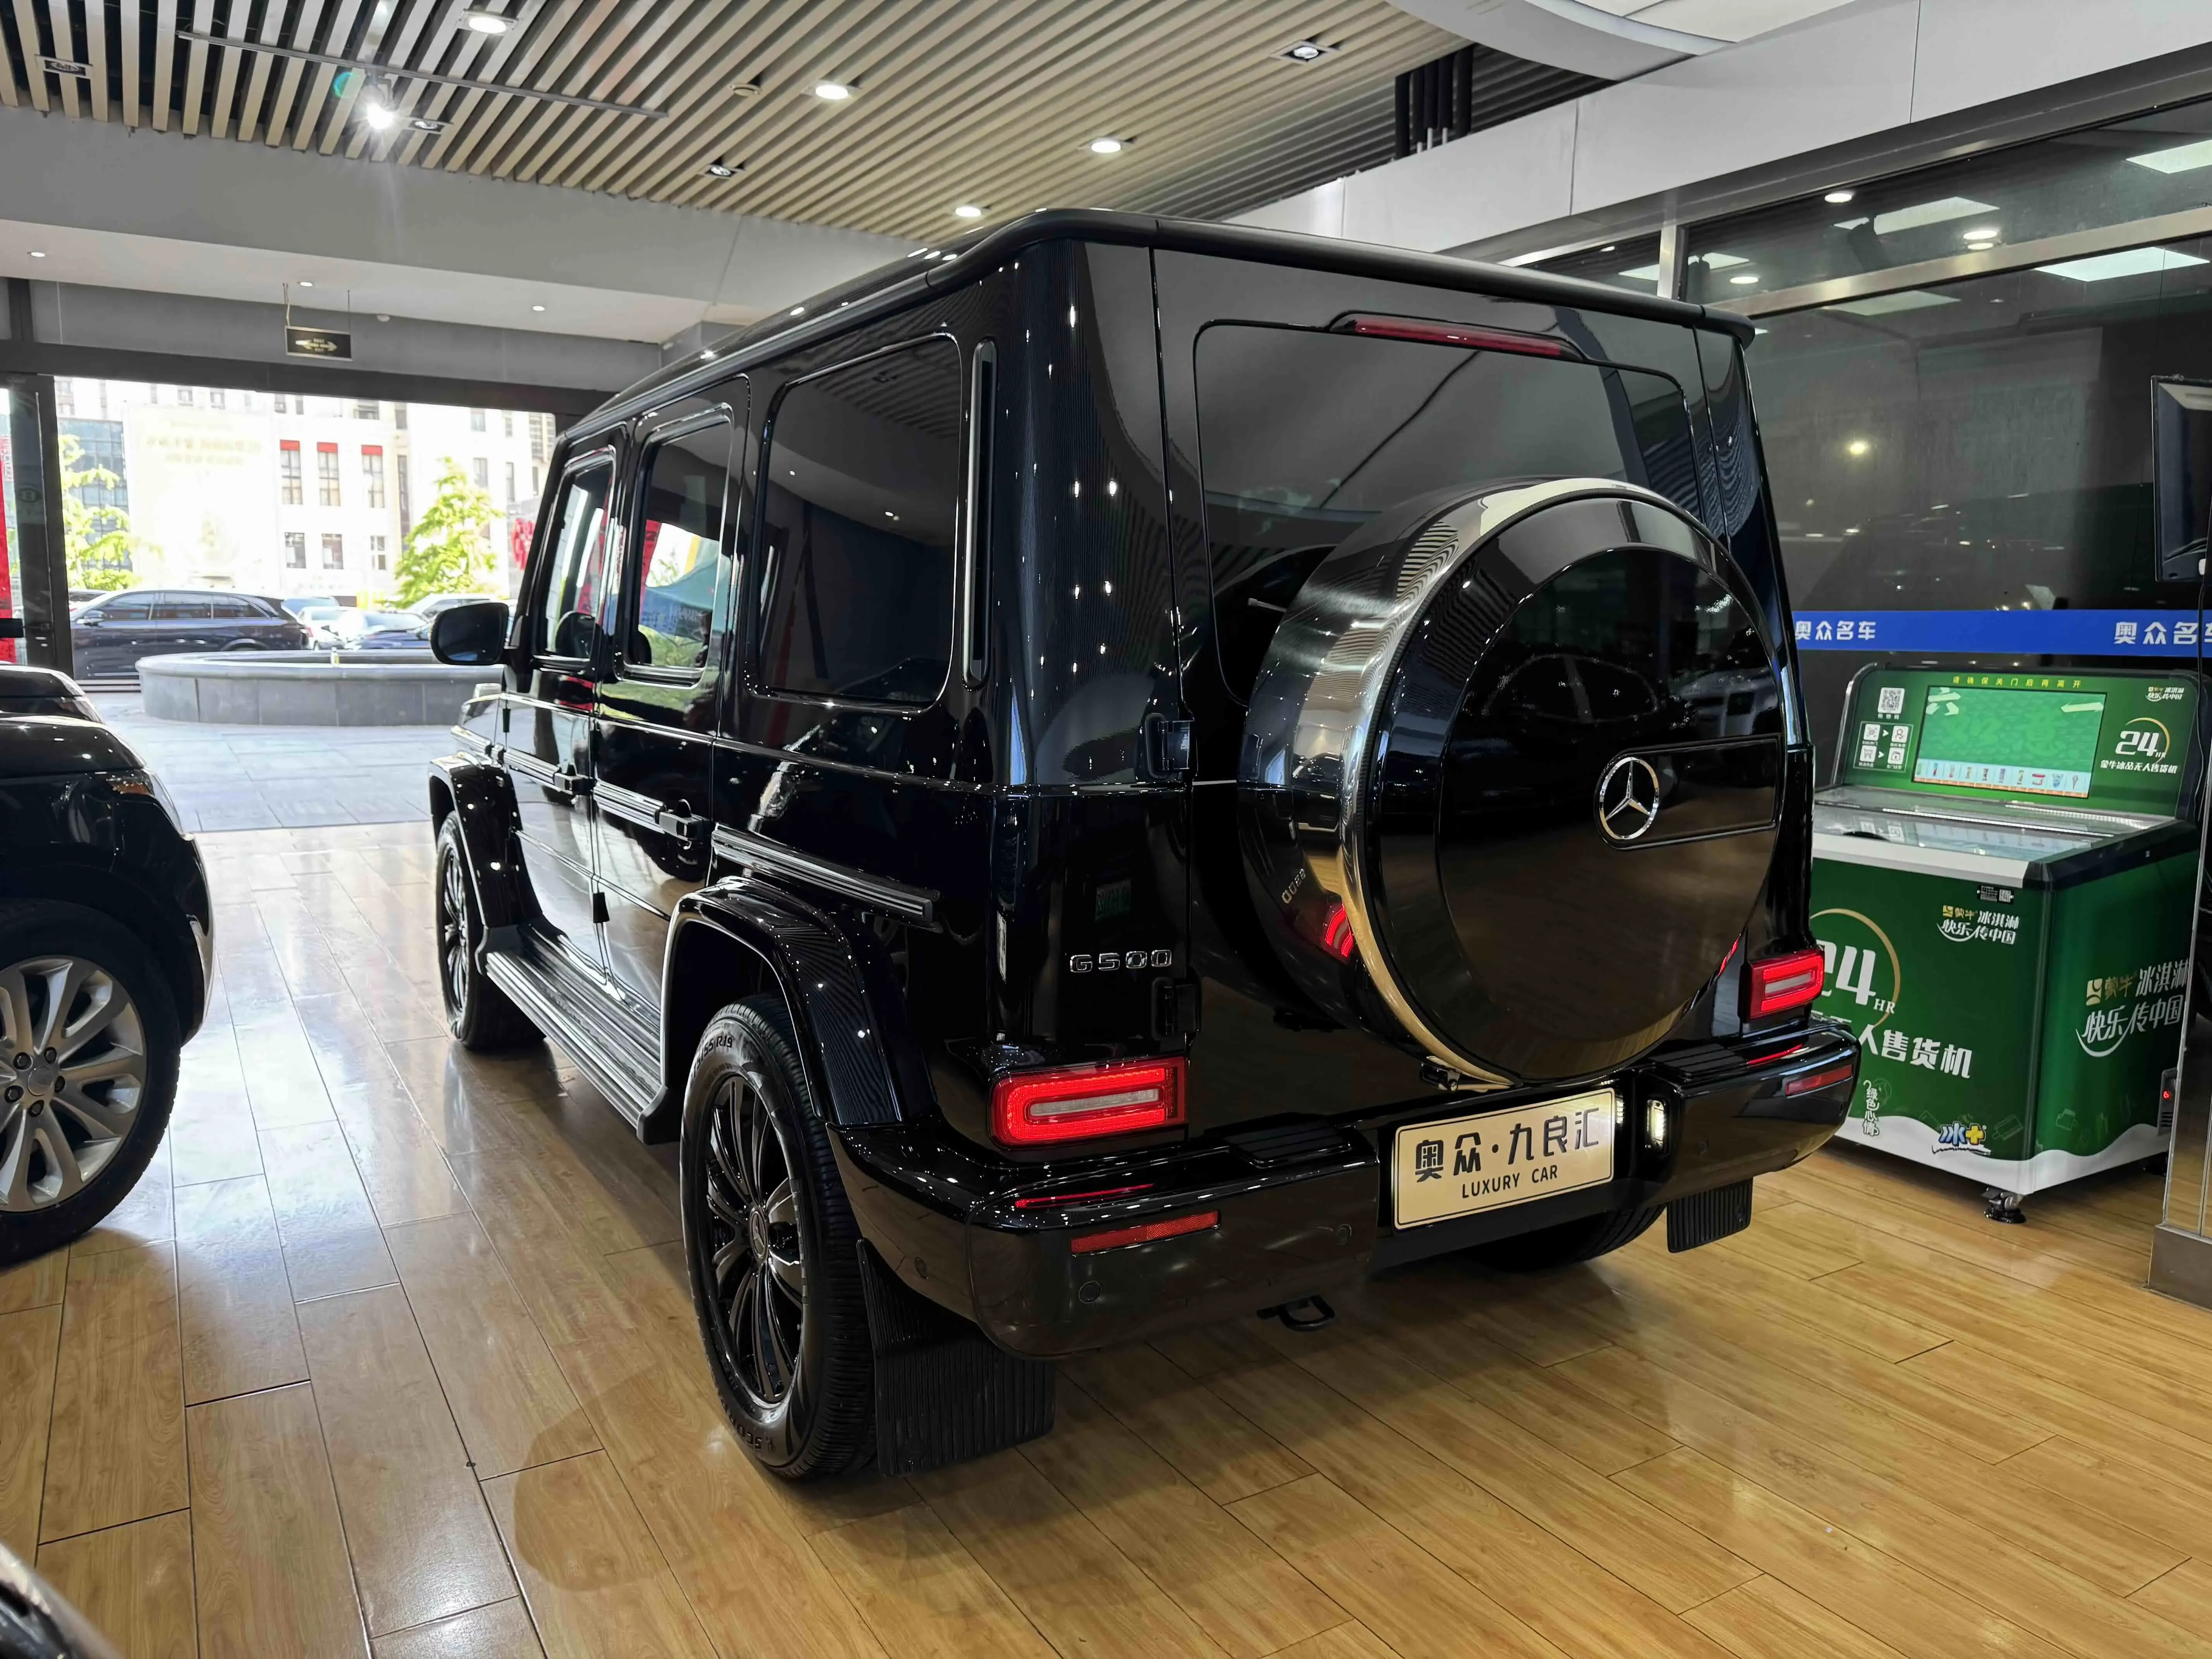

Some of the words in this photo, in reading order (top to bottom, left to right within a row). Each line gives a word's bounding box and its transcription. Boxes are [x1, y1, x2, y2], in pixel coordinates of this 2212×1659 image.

[1795, 620, 1876, 641] 奥众名车
[2115, 731, 2159, 756] 24
[1941, 919, 2016, 945] 快乐传中国
[1977, 910, 2020, 929] 冰淇淋
[1070, 950, 1172, 973] G500
[2135, 957, 2189, 997] 冰淇淋
[1873, 998, 1896, 1014] HR
[2081, 994, 2184, 1044] 快乐传中国
[1415, 1108, 1599, 1182] 奥众·九良汇
[1462, 1173, 1520, 1198] LUXURY
[1532, 1165, 1558, 1183] CAR
